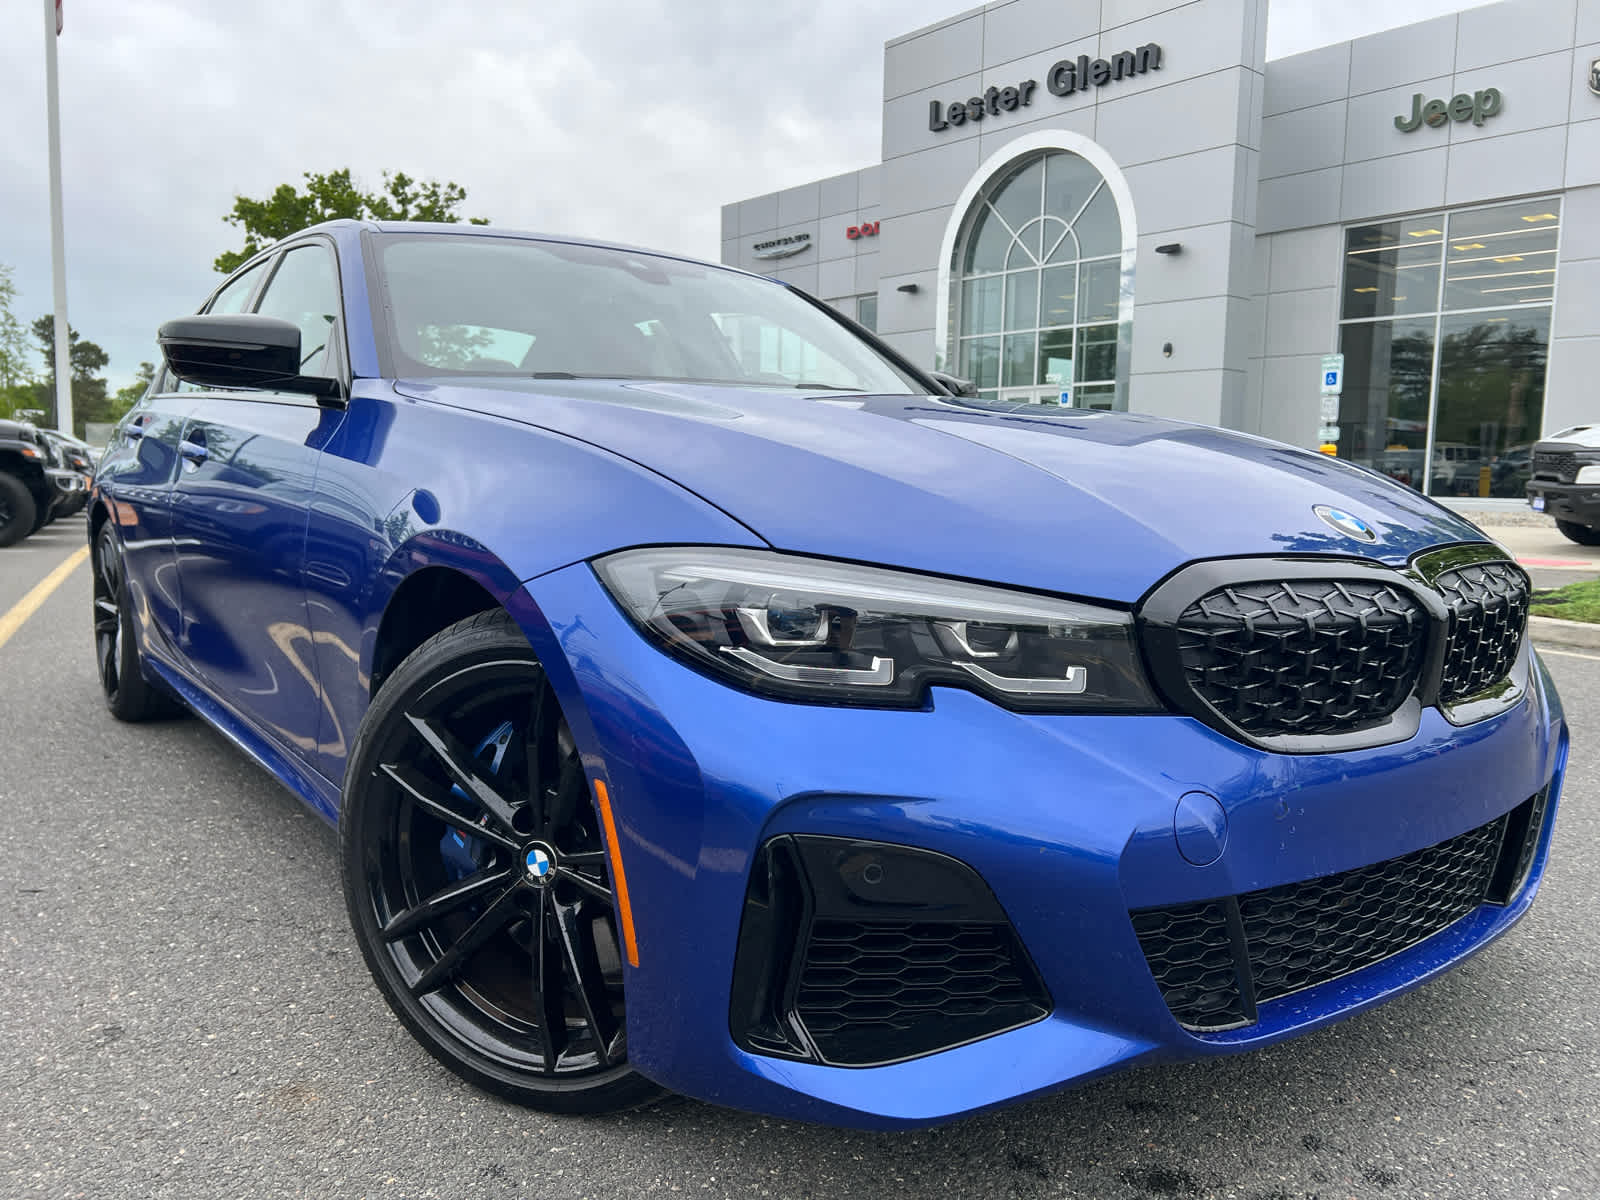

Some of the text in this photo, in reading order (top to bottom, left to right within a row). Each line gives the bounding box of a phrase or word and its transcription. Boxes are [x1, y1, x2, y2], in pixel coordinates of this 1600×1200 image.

[929, 42, 1162, 132] Lester Glenn
[1394, 87, 1503, 133] Jeep
